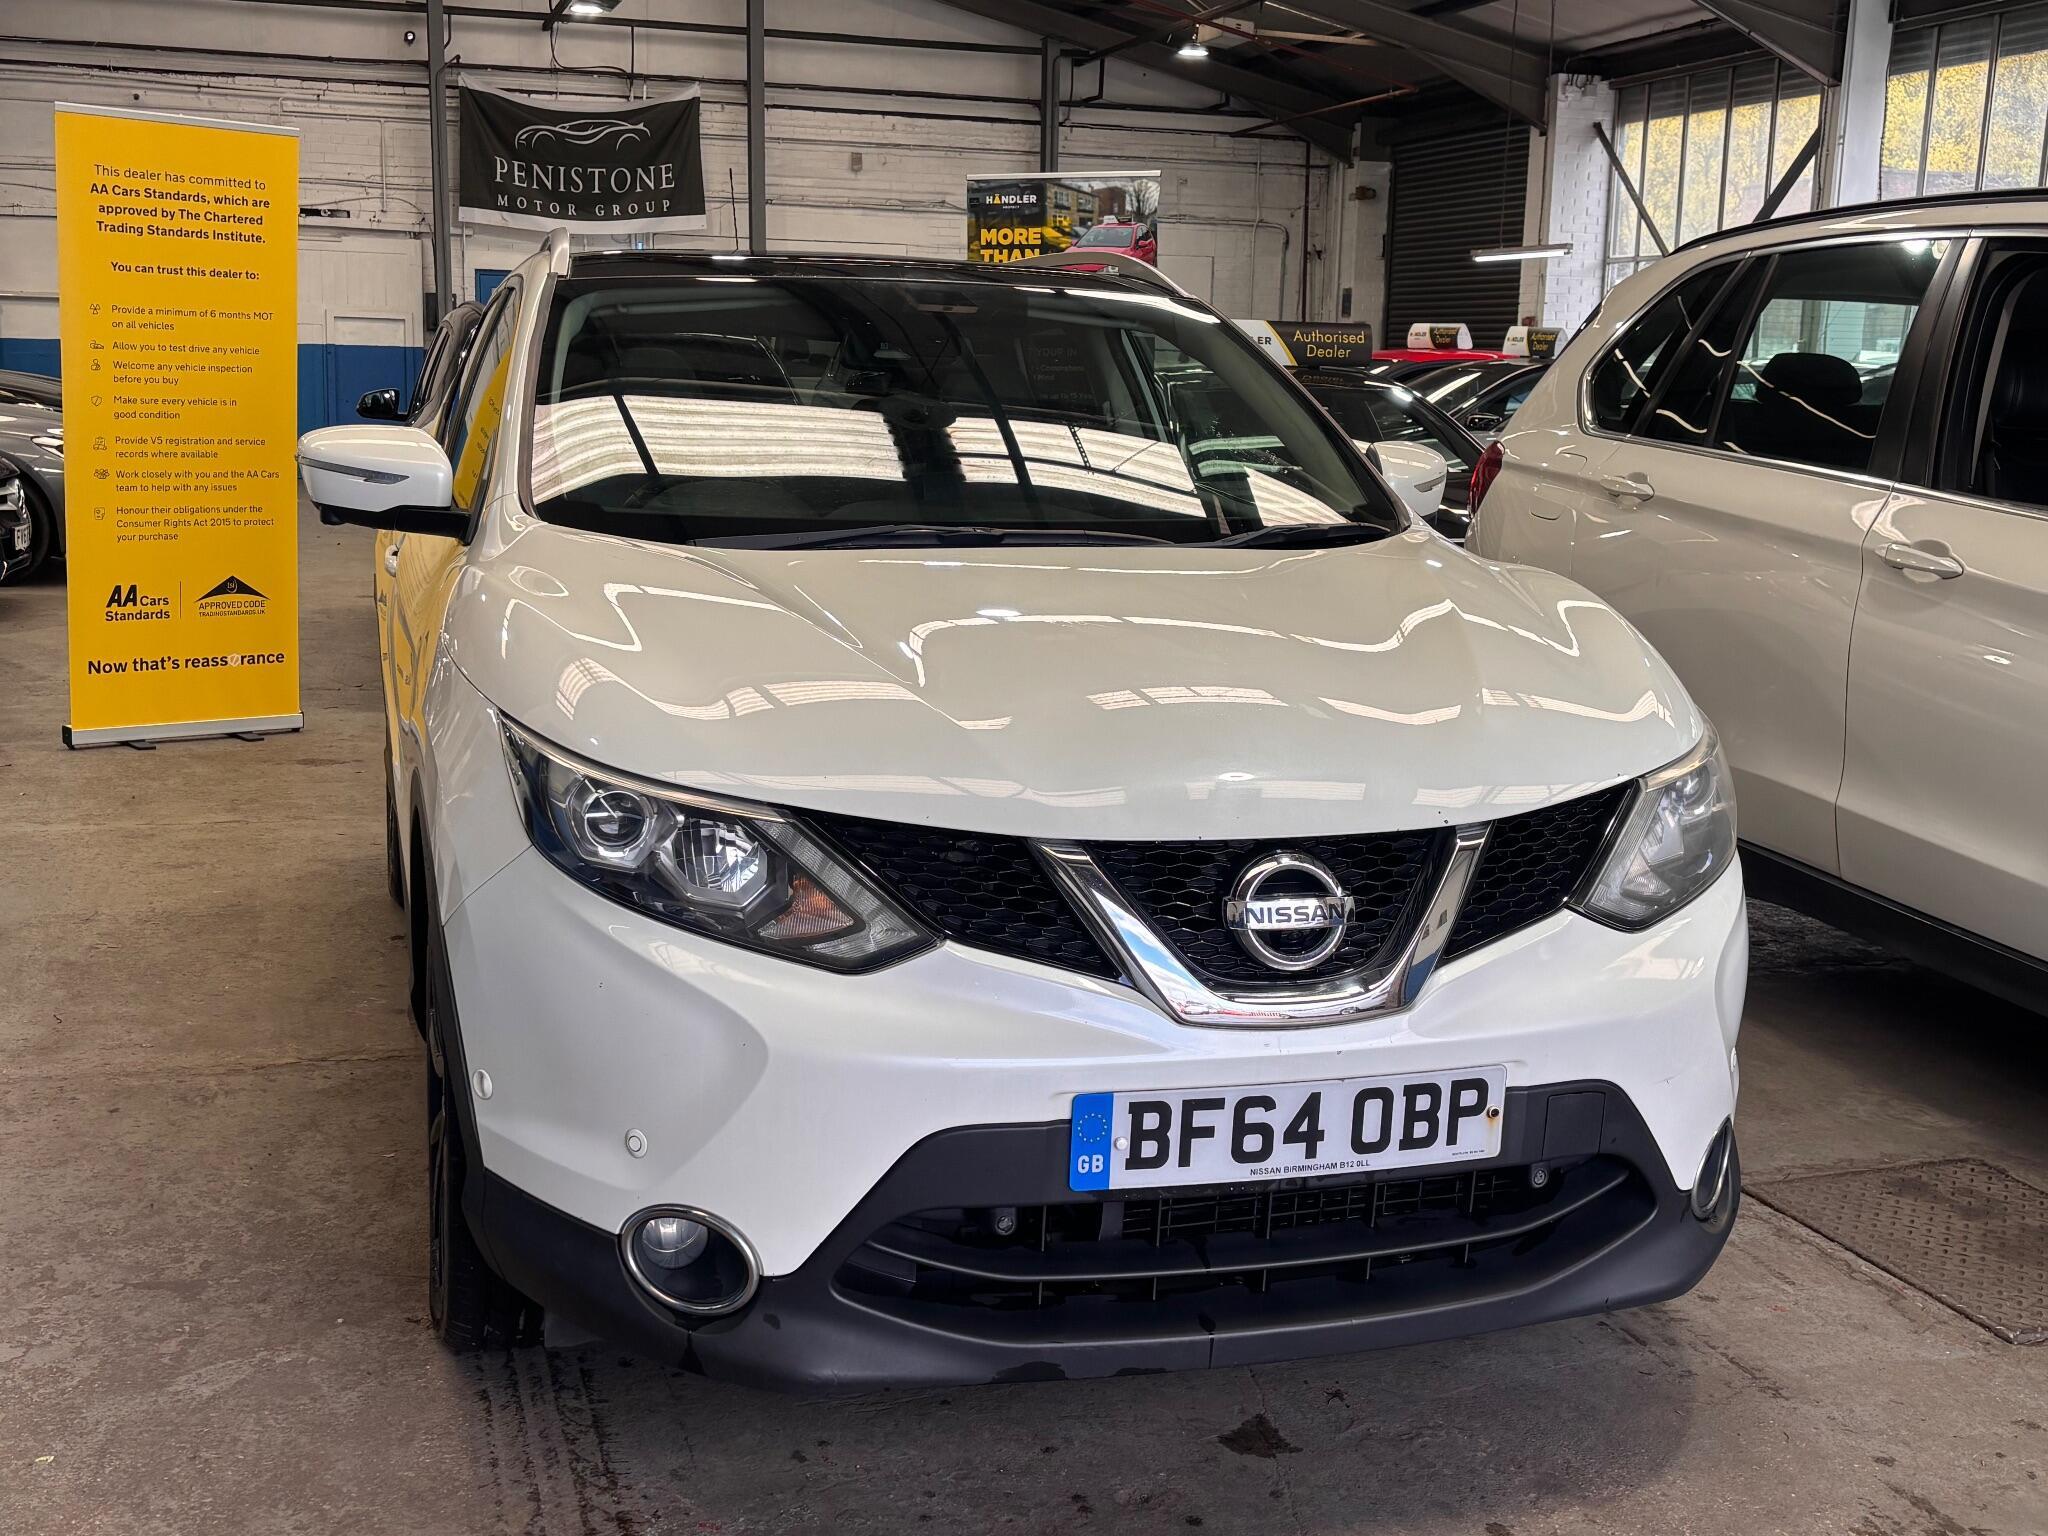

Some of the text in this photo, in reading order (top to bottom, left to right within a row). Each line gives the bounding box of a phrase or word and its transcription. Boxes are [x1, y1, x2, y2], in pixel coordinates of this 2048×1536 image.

[95, 164, 265, 190] This dealer has committed to
[494, 156, 675, 194] PENISTONE
[90, 184, 270, 208] AA Cars Standards, which are
[498, 194, 670, 216] MOTOR GROUP
[99, 205, 263, 225] approved by The Chartered
[96, 221, 265, 243] Trading Standards Institute.
[981, 228, 1041, 245] MORE
[981, 249, 1039, 263] THAN
[111, 262, 259, 279] You can trust this dealer to:
[112, 305, 145, 315] Provide
[156, 309, 197, 317] minimum
[200, 309, 209, 317] of
[219, 311, 250, 320] months
[254, 312, 274, 320] MOT
[126, 321, 136, 329] all
[138, 322, 174, 330] vehicles
[1294, 330, 1364, 344] Authorised
[113, 342, 137, 350] Allow
[141, 344, 155, 353] you
[170, 344, 185, 352] test
[189, 345, 208, 353] drive
[213, 346, 228, 355] any
[231, 346, 259, 354] vehicle
[1307, 345, 1351, 358] Dealer
[113, 361, 252, 373] Welcome any vehicle inspection
[114, 375, 141, 384] before
[163, 376, 179, 385] buy
[114, 396, 137, 404] Make
[140, 397, 159, 405] sure
[162, 398, 185, 407] every
[188, 397, 217, 406] vehicle
[230, 398, 237, 406] in
[114, 411, 180, 420] good condition
[116, 437, 148, 445] Provide
[151, 437, 162, 445] V5
[165, 437, 214, 447] registration
[217, 437, 232, 445] and
[116, 450, 218, 458] records where available
[116, 470, 279, 480] Work closely with you and the AA Cars
[117, 484, 138, 492] team
[152, 484, 170, 493] help
[173, 483, 191, 491] with
[194, 485, 208, 493] any
[211, 483, 237, 491] issues
[117, 505, 262, 515] Honour their obligations under the
[117, 519, 161, 528] Consumer
[164, 519, 191, 528] Rights
[194, 518, 208, 527] Act
[211, 518, 231, 526] 2015
[244, 518, 274, 527] protect
[117, 532, 178, 543] your purchase
[106, 585, 169, 607] AA Cars
[199, 600, 265, 609] APPROVED CODE
[106, 609, 170, 621] Standards
[88, 659, 127, 674] Now
[133, 657, 180, 672] that's
[1245, 903, 1344, 923] NISSAN
[1125, 1078, 1488, 1171] BF64 OBP
[1078, 1155, 1104, 1174] GB
[1250, 1167, 1281, 1176] NISSAN
[1284, 1162, 1338, 1173] BIRMINGHAM
[1340, 1161, 1355, 1169] B12
